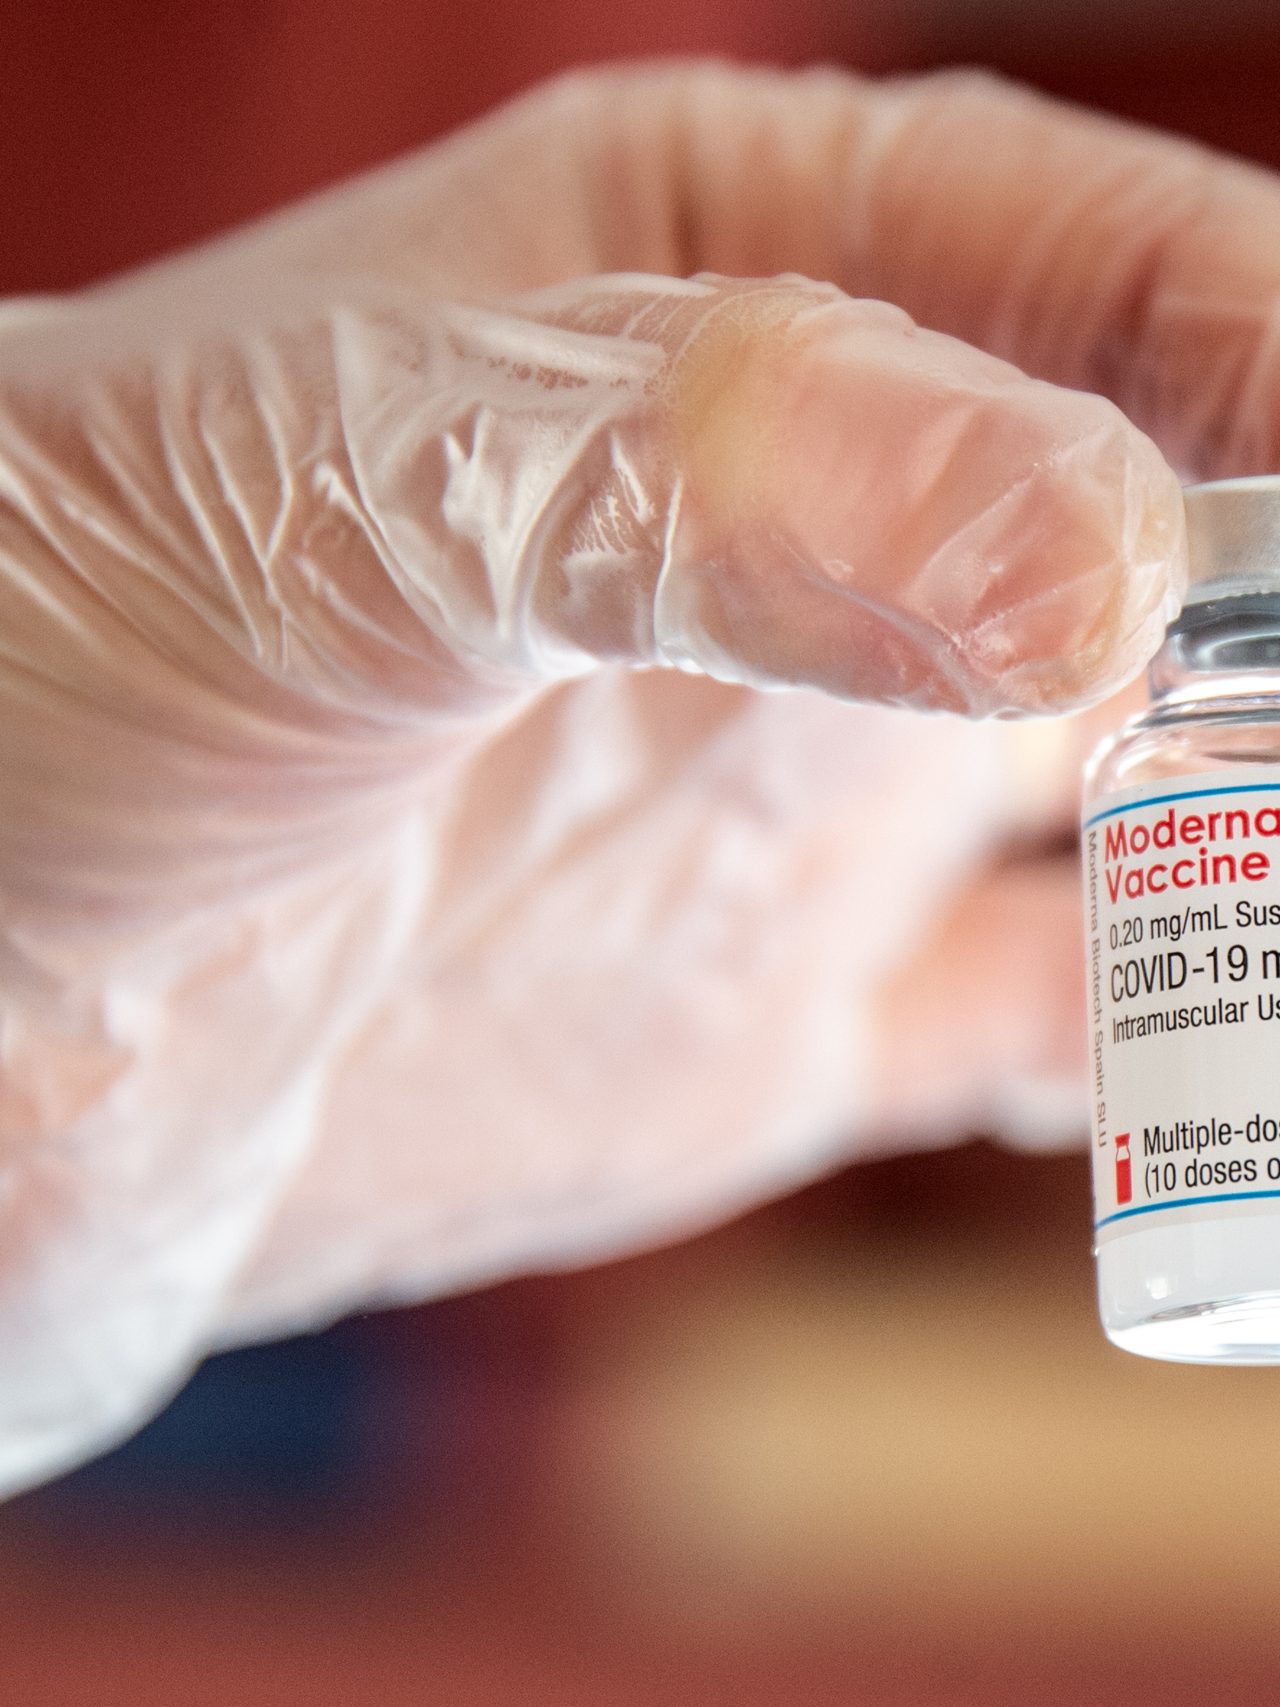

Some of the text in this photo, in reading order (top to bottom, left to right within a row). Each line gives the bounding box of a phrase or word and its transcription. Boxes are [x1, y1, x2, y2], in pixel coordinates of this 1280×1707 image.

[1105, 847, 1270, 904] Vaccine
[1109, 917, 1143, 950] 0.20
[1150, 904, 1228, 940] mg/mL
[1088, 831, 1107, 1148] Moderna Biotech Spain SLU
[1111, 945, 1248, 1001] COVID-19
[1113, 998, 1249, 1044] Intramuscular
[1145, 1163, 1176, 1197] (10
[1185, 1158, 1257, 1186] doses
